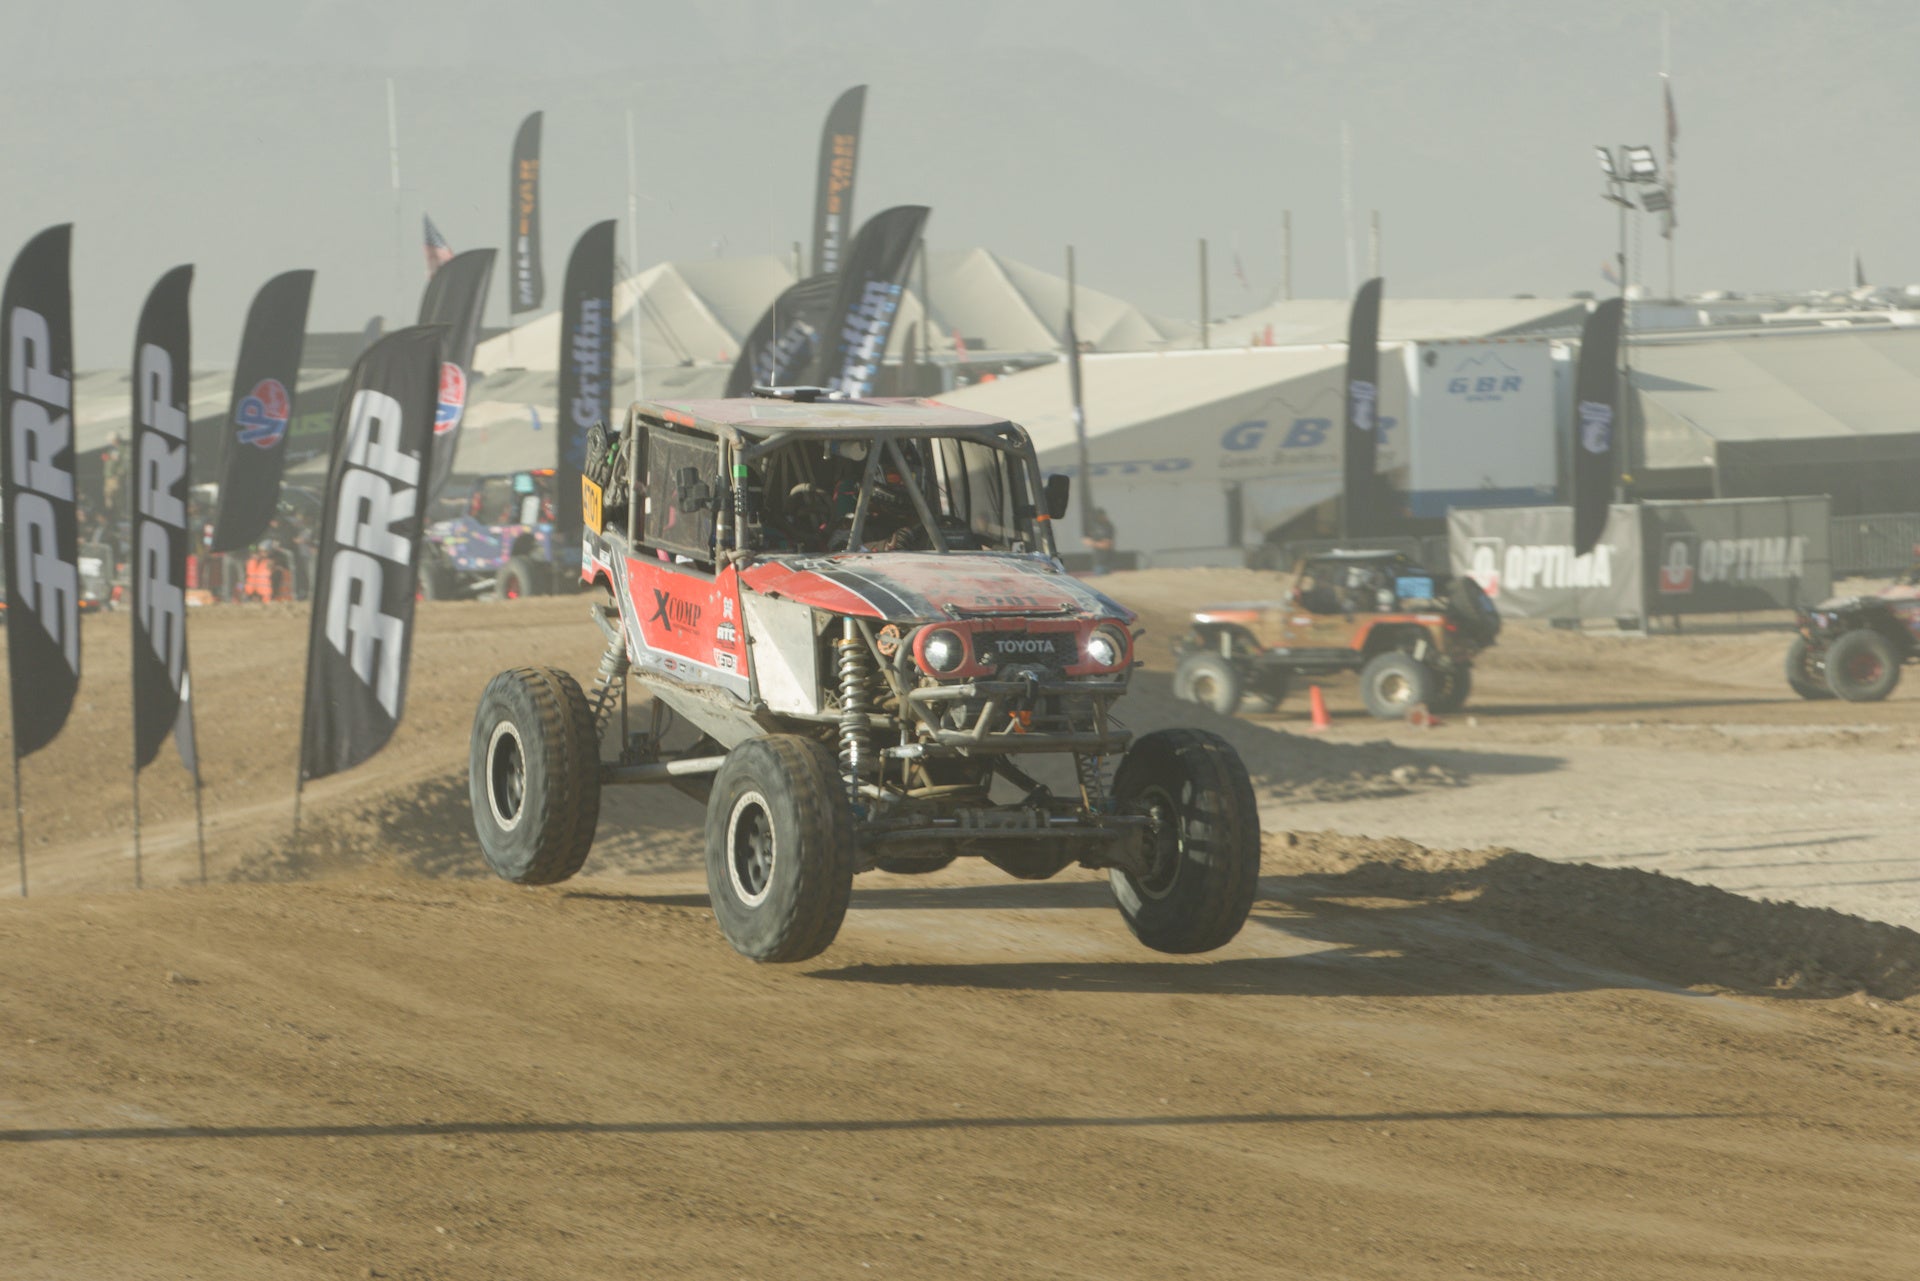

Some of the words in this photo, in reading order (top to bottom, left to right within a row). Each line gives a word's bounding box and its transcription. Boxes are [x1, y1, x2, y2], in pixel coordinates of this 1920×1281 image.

[573, 297, 602, 428] Griffin
[10, 307, 79, 676] PRP
[139, 343, 188, 692] PRP
[326, 390, 421, 719] PRP
[1504, 543, 1612, 590] OPTIMA
[1699, 536, 1805, 583] OPTIMA
[996, 640, 1055, 653] TOYOTA
